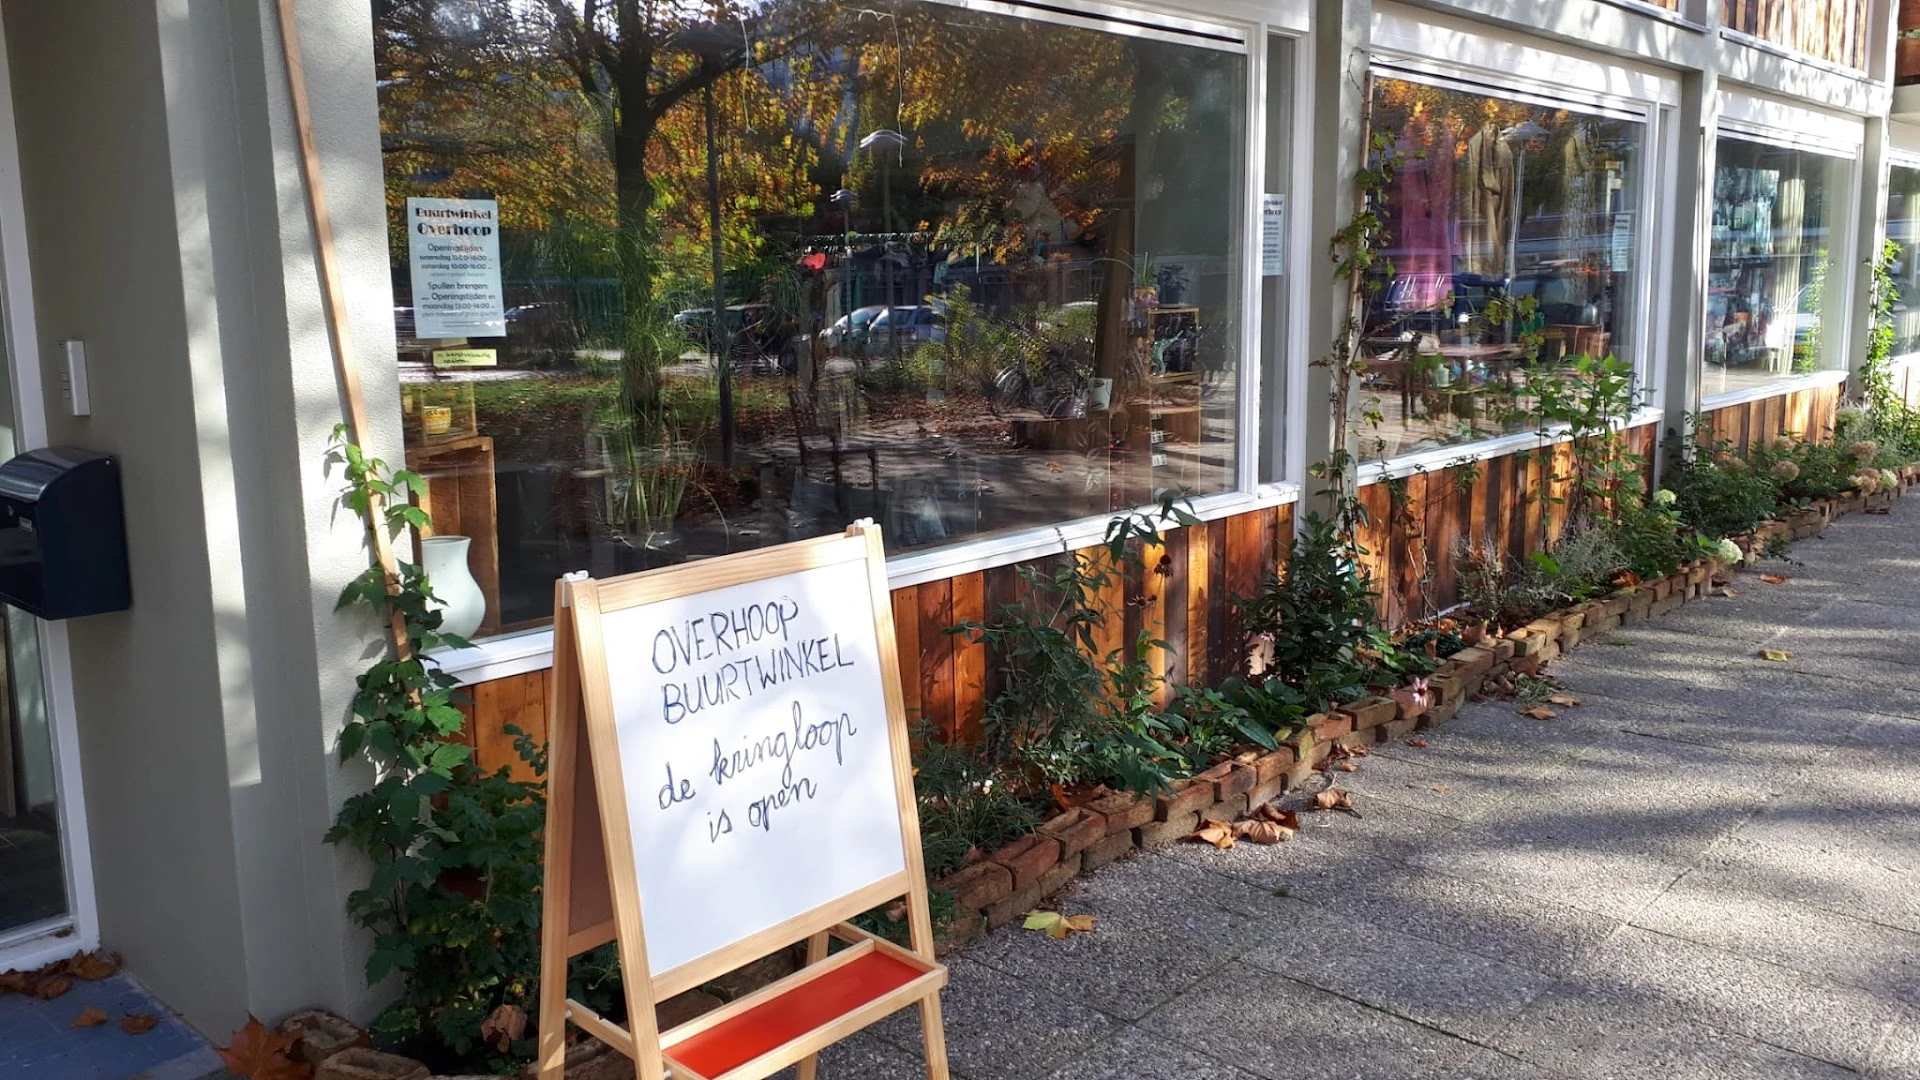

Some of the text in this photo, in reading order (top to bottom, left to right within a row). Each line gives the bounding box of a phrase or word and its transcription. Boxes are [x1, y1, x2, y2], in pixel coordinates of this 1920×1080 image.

[415, 207, 492, 219] Buurtwinkel
[417, 222, 492, 236] Overhoop
[419, 253, 451, 261] woensdag
[427, 281, 455, 290] Spullen
[431, 292, 487, 301] Openingstijden
[422, 303, 454, 311] maandag
[652, 595, 798, 674] OVERHOOP
[662, 634, 854, 724] BUURTWINKEL
[658, 701, 857, 810] de kringloop
[707, 777, 817, 844] is open
